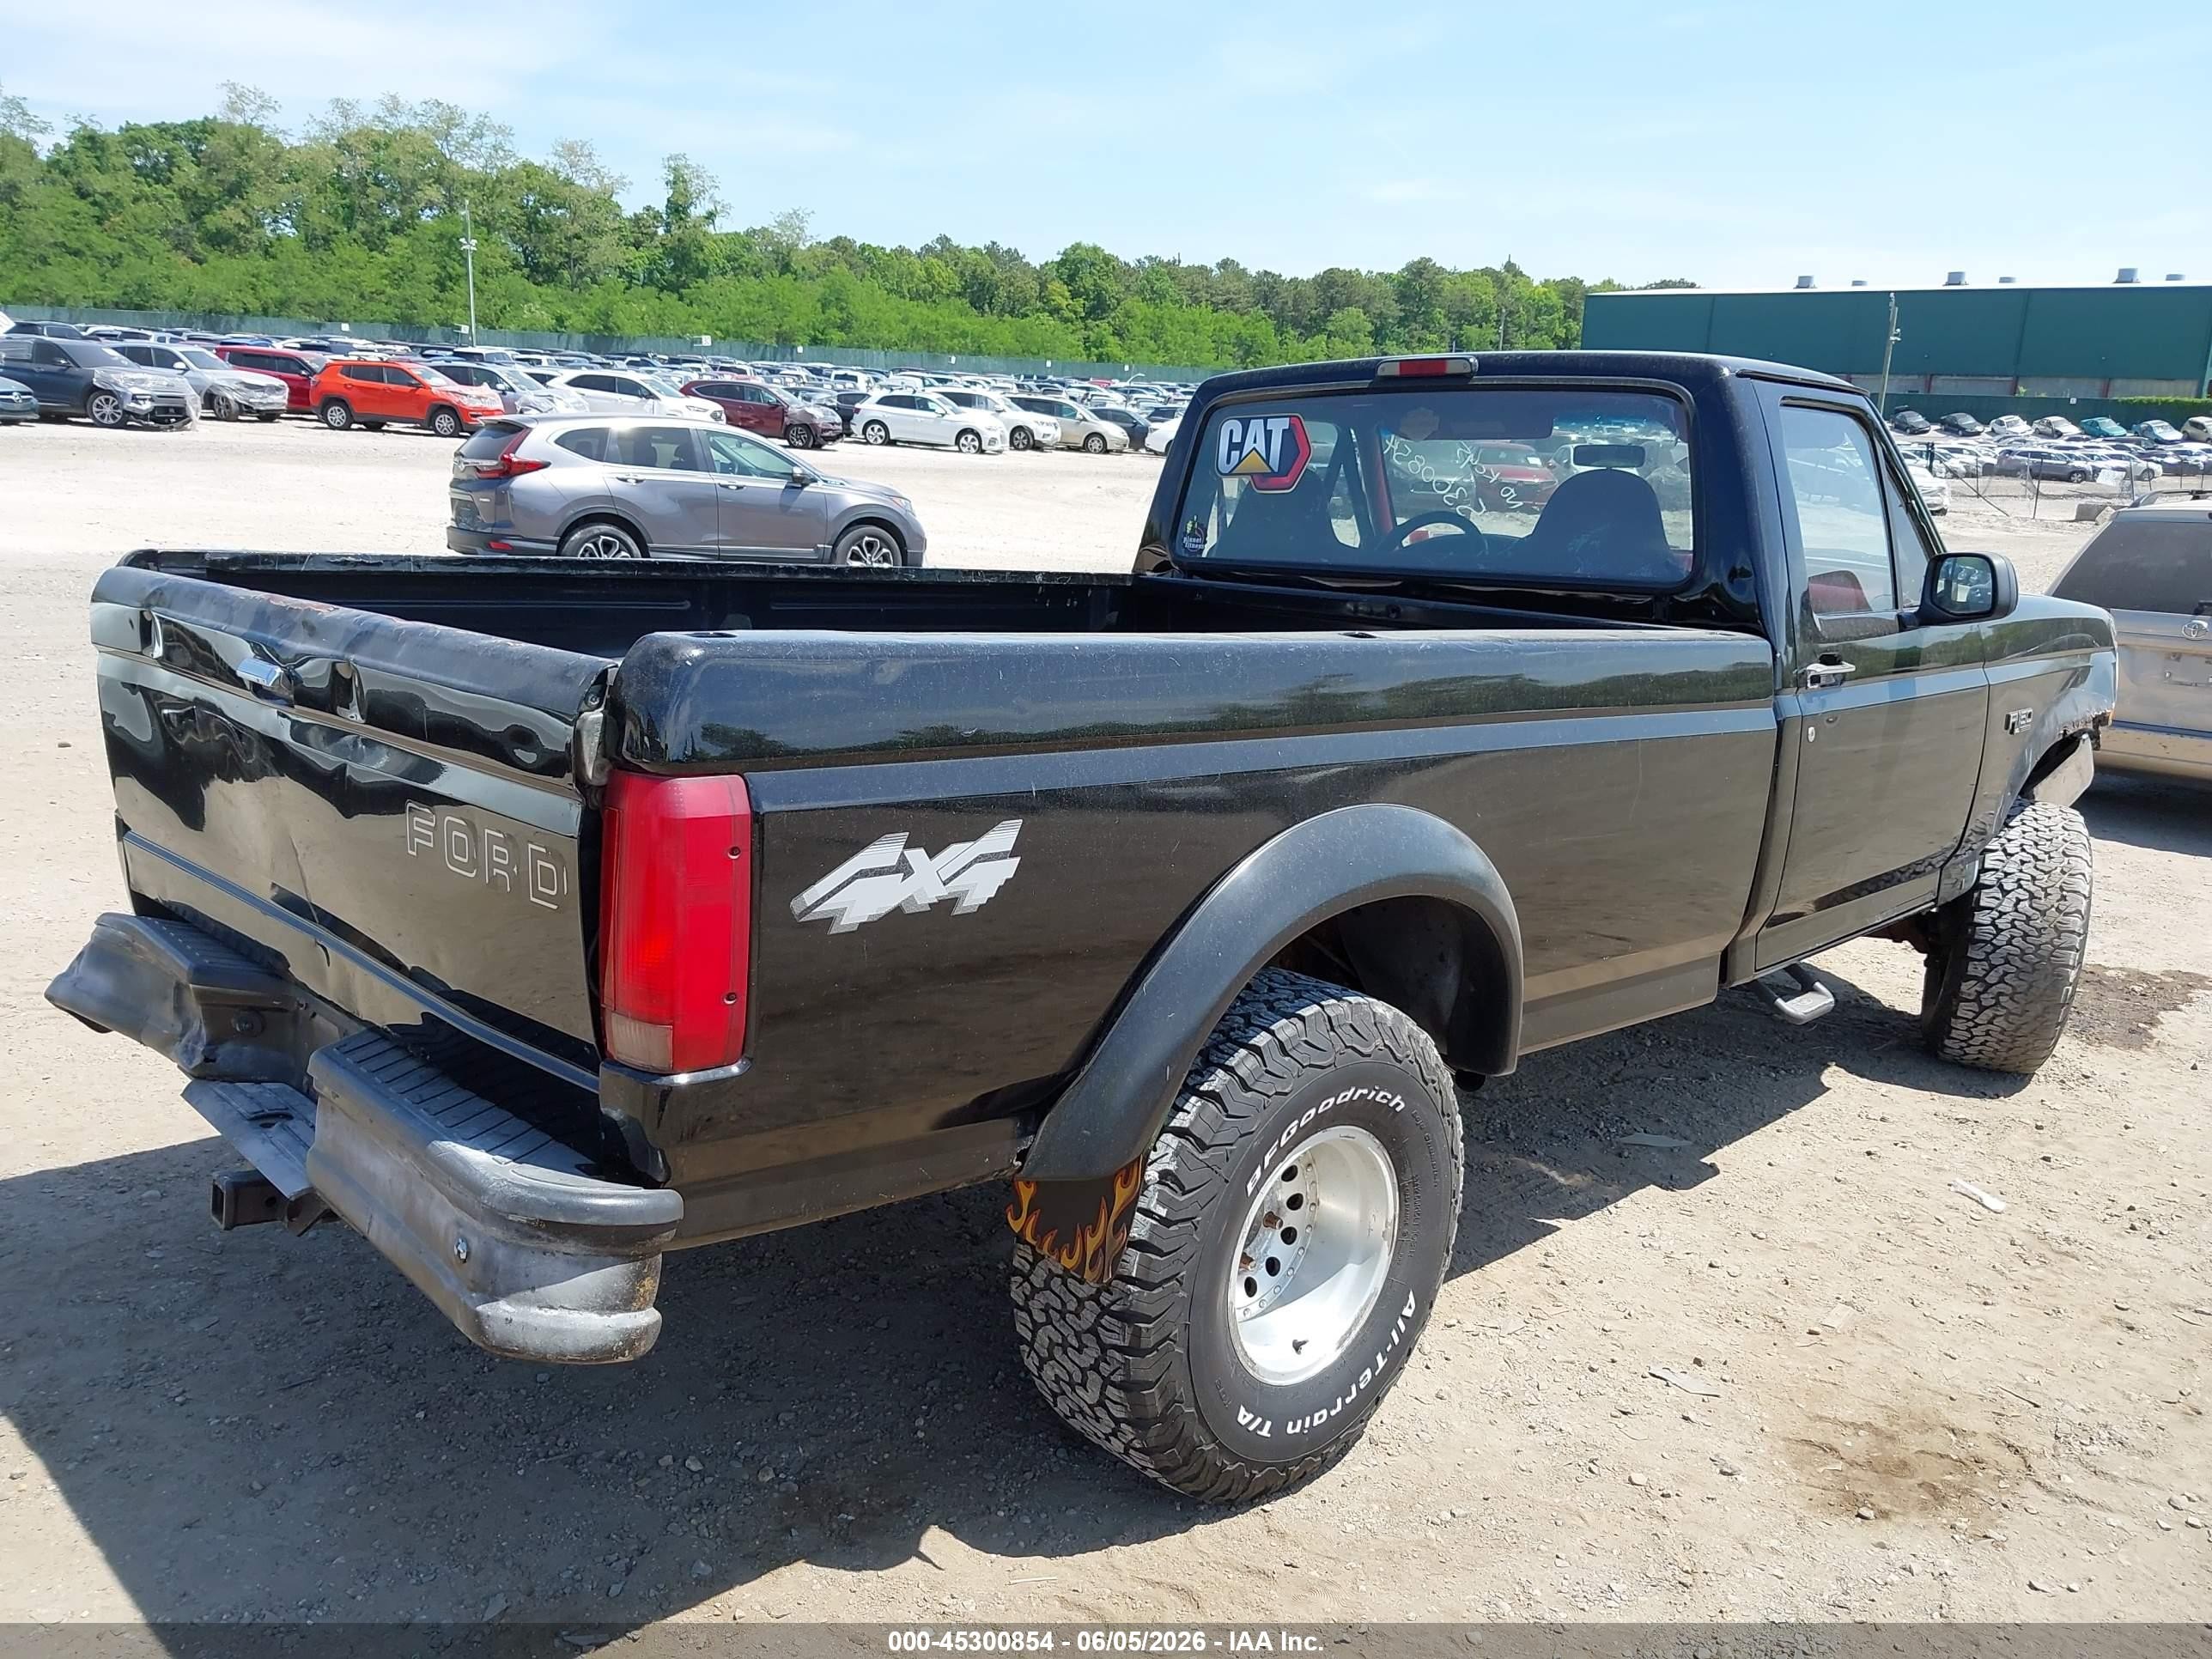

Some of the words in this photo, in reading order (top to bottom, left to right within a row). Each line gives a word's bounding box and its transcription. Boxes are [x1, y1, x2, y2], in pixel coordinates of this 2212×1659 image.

[1218, 416, 1290, 474] CAT
[405, 799, 568, 910] FORD
[1247, 1085, 1406, 1198] BFGoodrich
[1285, 1290, 1416, 1435] All-Terrain
[1237, 1405, 1272, 1437] T/A
